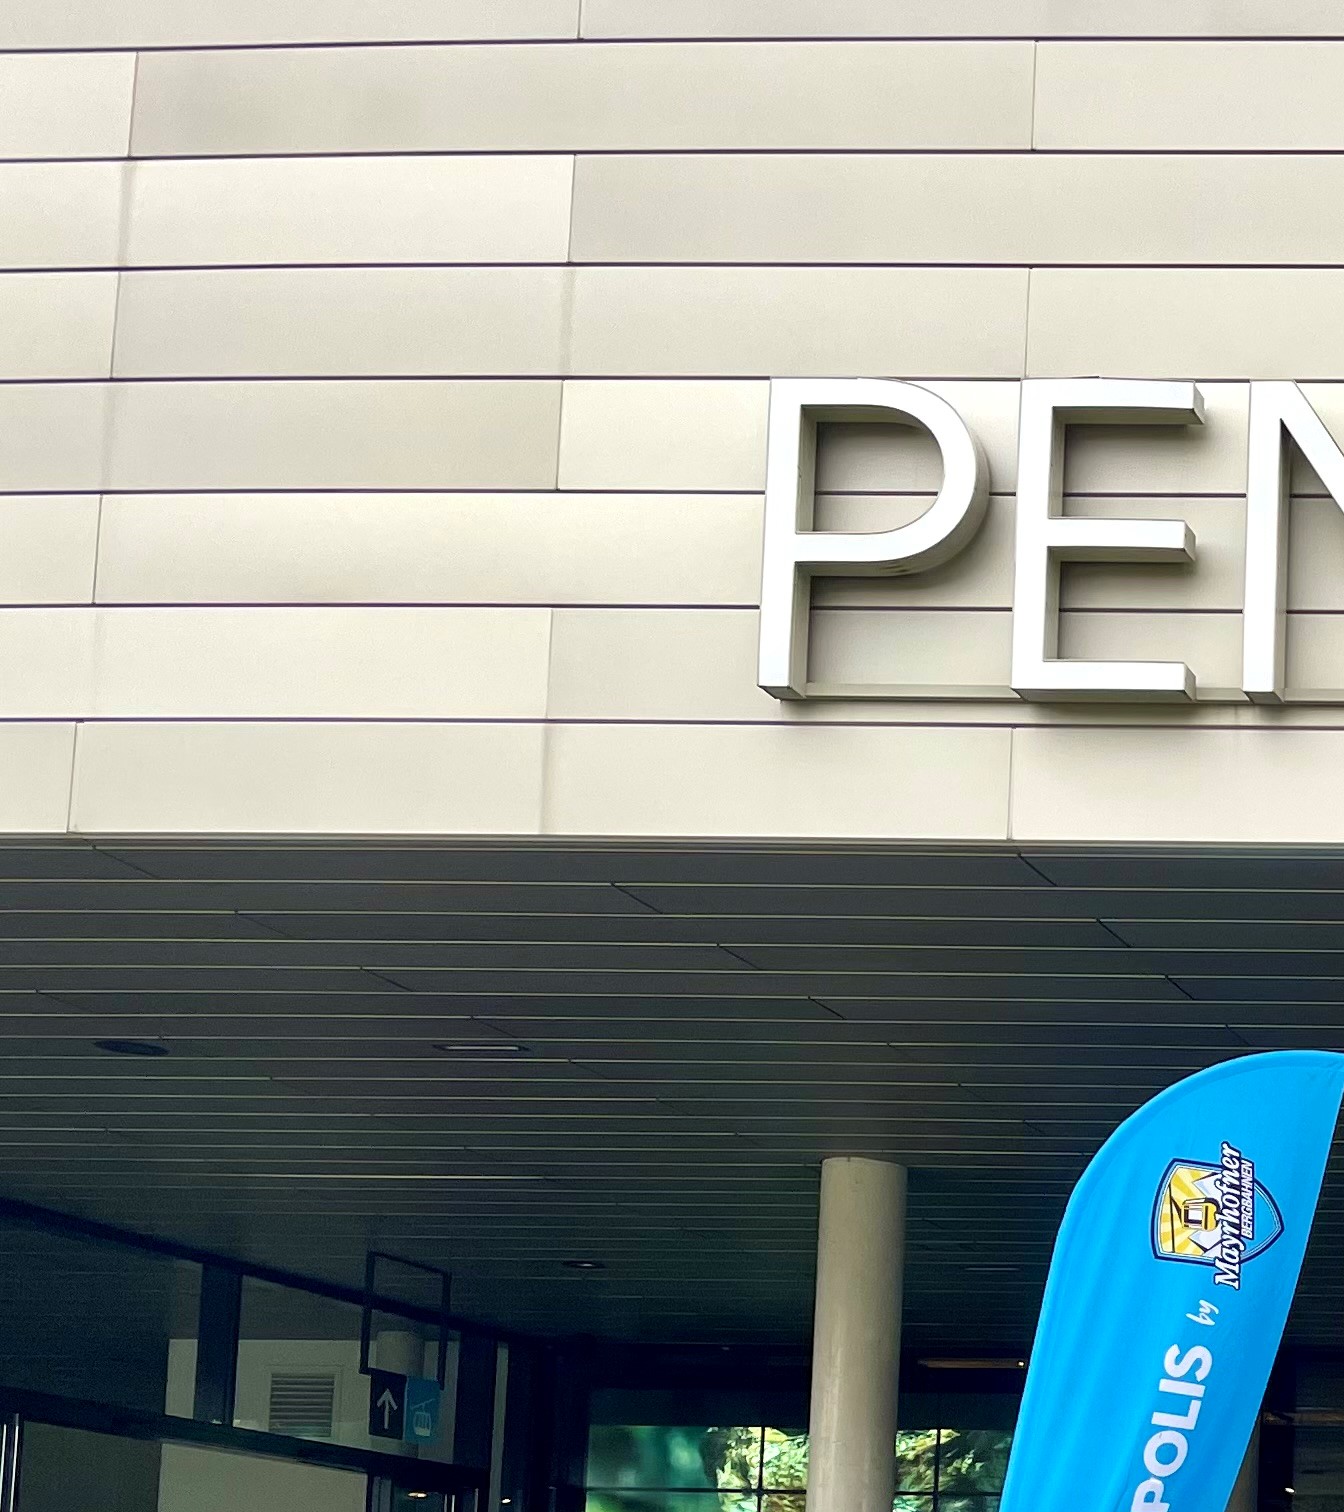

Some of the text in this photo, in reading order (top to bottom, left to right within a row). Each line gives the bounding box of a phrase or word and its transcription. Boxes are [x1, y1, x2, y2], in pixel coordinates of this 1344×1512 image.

[1214, 1141, 1246, 1291] Mayrhofner
[1241, 1158, 1255, 1240] BERGBAHNEN
[1186, 1298, 1220, 1327] by
